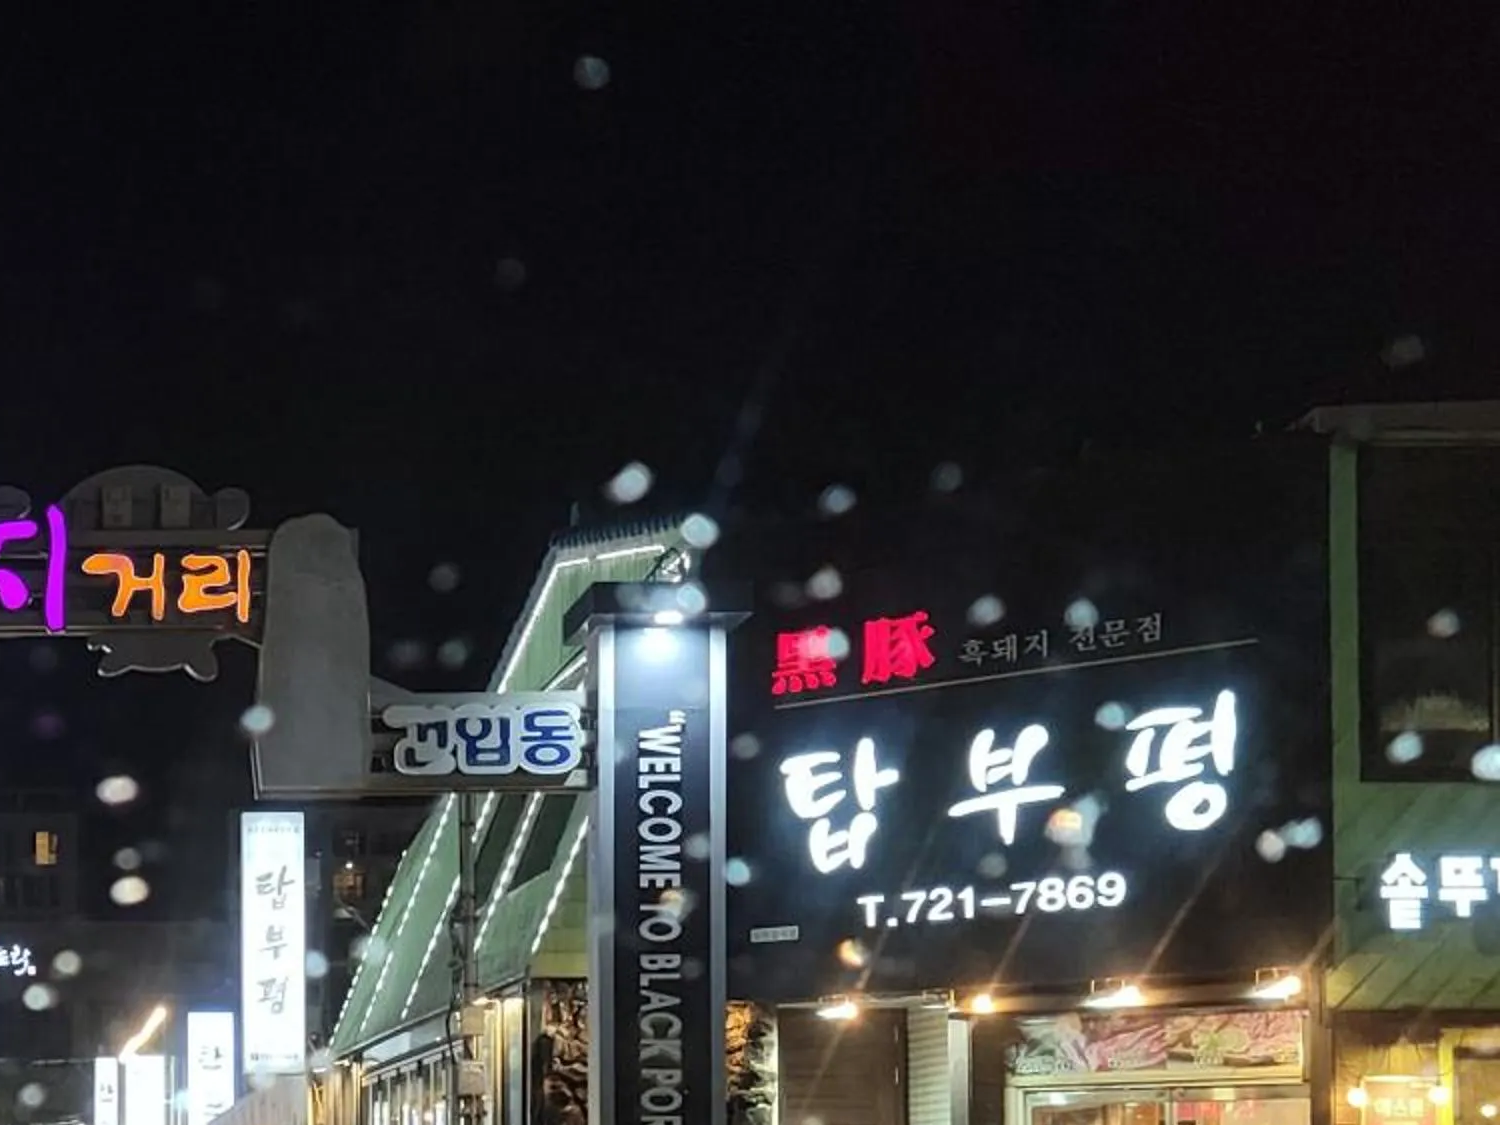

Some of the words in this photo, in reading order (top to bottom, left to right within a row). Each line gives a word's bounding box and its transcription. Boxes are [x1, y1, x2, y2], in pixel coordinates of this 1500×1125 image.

[81, 549, 251, 622] 거리
[958, 629, 1050, 667] 흑돼지
[1067, 612, 1164, 654] 전문점
[779, 688, 1238, 874] 탑부평
[638, 895, 684, 942] TO
[856, 871, 1127, 929] T.721-7869
[255, 864, 296, 1016] 탑부평
[639, 953, 684, 1061] BLACK
